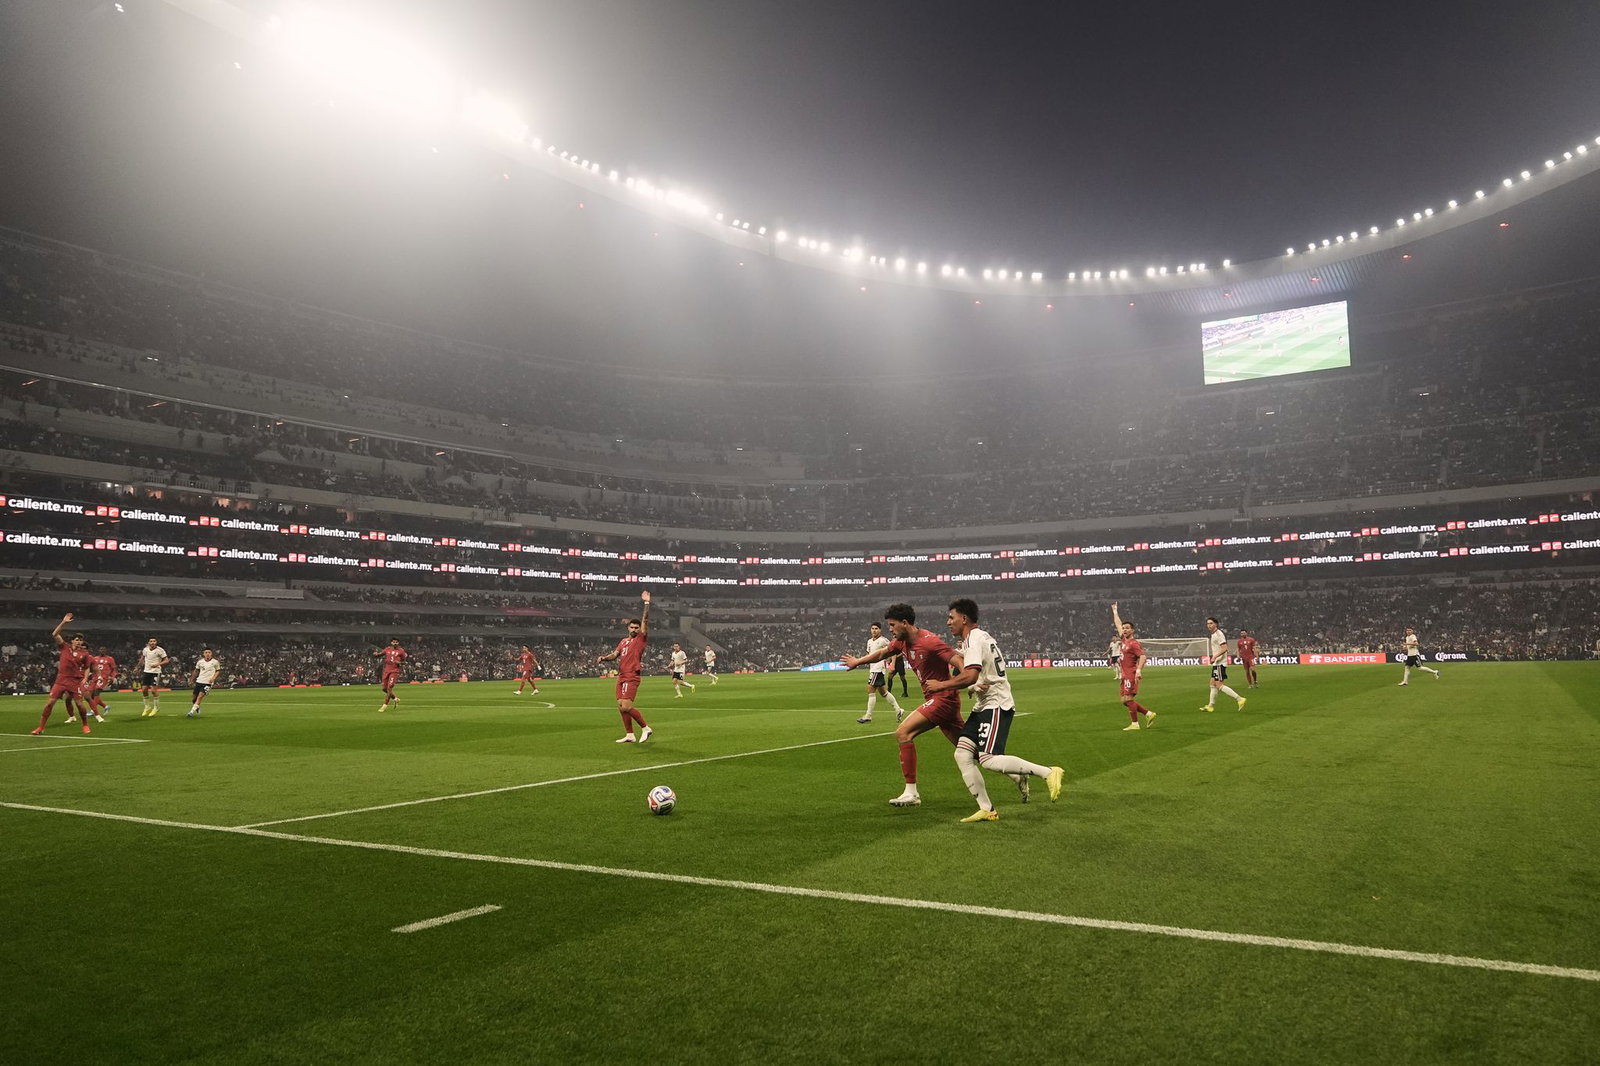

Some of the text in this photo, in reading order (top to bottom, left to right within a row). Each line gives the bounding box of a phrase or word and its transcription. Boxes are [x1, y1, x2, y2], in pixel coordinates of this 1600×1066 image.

[7, 498, 84, 514] caliente.mx
[120, 510, 187, 523] caliente.mx
[220, 519, 280, 531] caliente.mx
[308, 527, 361, 538] caliente.mx
[386, 534, 434, 544] caliente.mx
[456, 540, 500, 550] caliente.mx
[521, 545, 562, 554] caliente.mx
[580, 549, 620, 559] caliente.mx
[637, 552, 677, 562] caliente.mx
[696, 555, 738, 564] caliente.mx
[759, 557, 801, 565] caliente.mx
[822, 556, 865, 565] caliente.mx
[886, 554, 929, 563] caliente.mx
[949, 551, 992, 561] caliente.mx
[1014, 548, 1058, 558] caliente.mx
[1080, 544, 1126, 554] caliente.mx
[1149, 540, 1197, 550] caliente.mx
[1221, 536, 1272, 545] caliente.mx
[1299, 530, 1352, 541] caliente.mx
[1379, 524, 1437, 534] caliente.mx
[1466, 518, 1528, 528] caliente.mx
[1560, 511, 1600, 521] calient
[5, 533, 82, 547] caliente.mx
[118, 542, 185, 554] caliente.mx
[219, 549, 279, 560] caliente.mx
[306, 555, 360, 566] caliente.mx
[385, 560, 433, 570] caliente.mx
[455, 565, 500, 574] caliente.mx
[520, 569, 562, 578] caliente.mx
[580, 572, 619, 582] caliente.mx
[637, 575, 677, 584] caliente.mx
[696, 576, 738, 586] caliente.mx
[759, 577, 802, 586] caliente.mx
[822, 577, 866, 585] caliente.mx
[886, 575, 930, 584] caliente.mx
[950, 573, 994, 582] caliente.mx
[1015, 570, 1060, 579] caliente.mx
[1081, 567, 1128, 576] caliente.mx
[1151, 563, 1199, 573] caliente.mx
[1223, 559, 1274, 569] caliente.mx
[1301, 555, 1354, 565] caliente.mx
[1381, 550, 1439, 560] caliente.mx
[1468, 545, 1530, 554] caliente.mx
[1146, 657, 1200, 666] aliente.mx
[1324, 655, 1377, 663] BANORTE
[1395, 653, 1427, 663] Coa
[1435, 651, 1468, 662] Corona
[1052, 657, 1108, 667] caliente.mx
